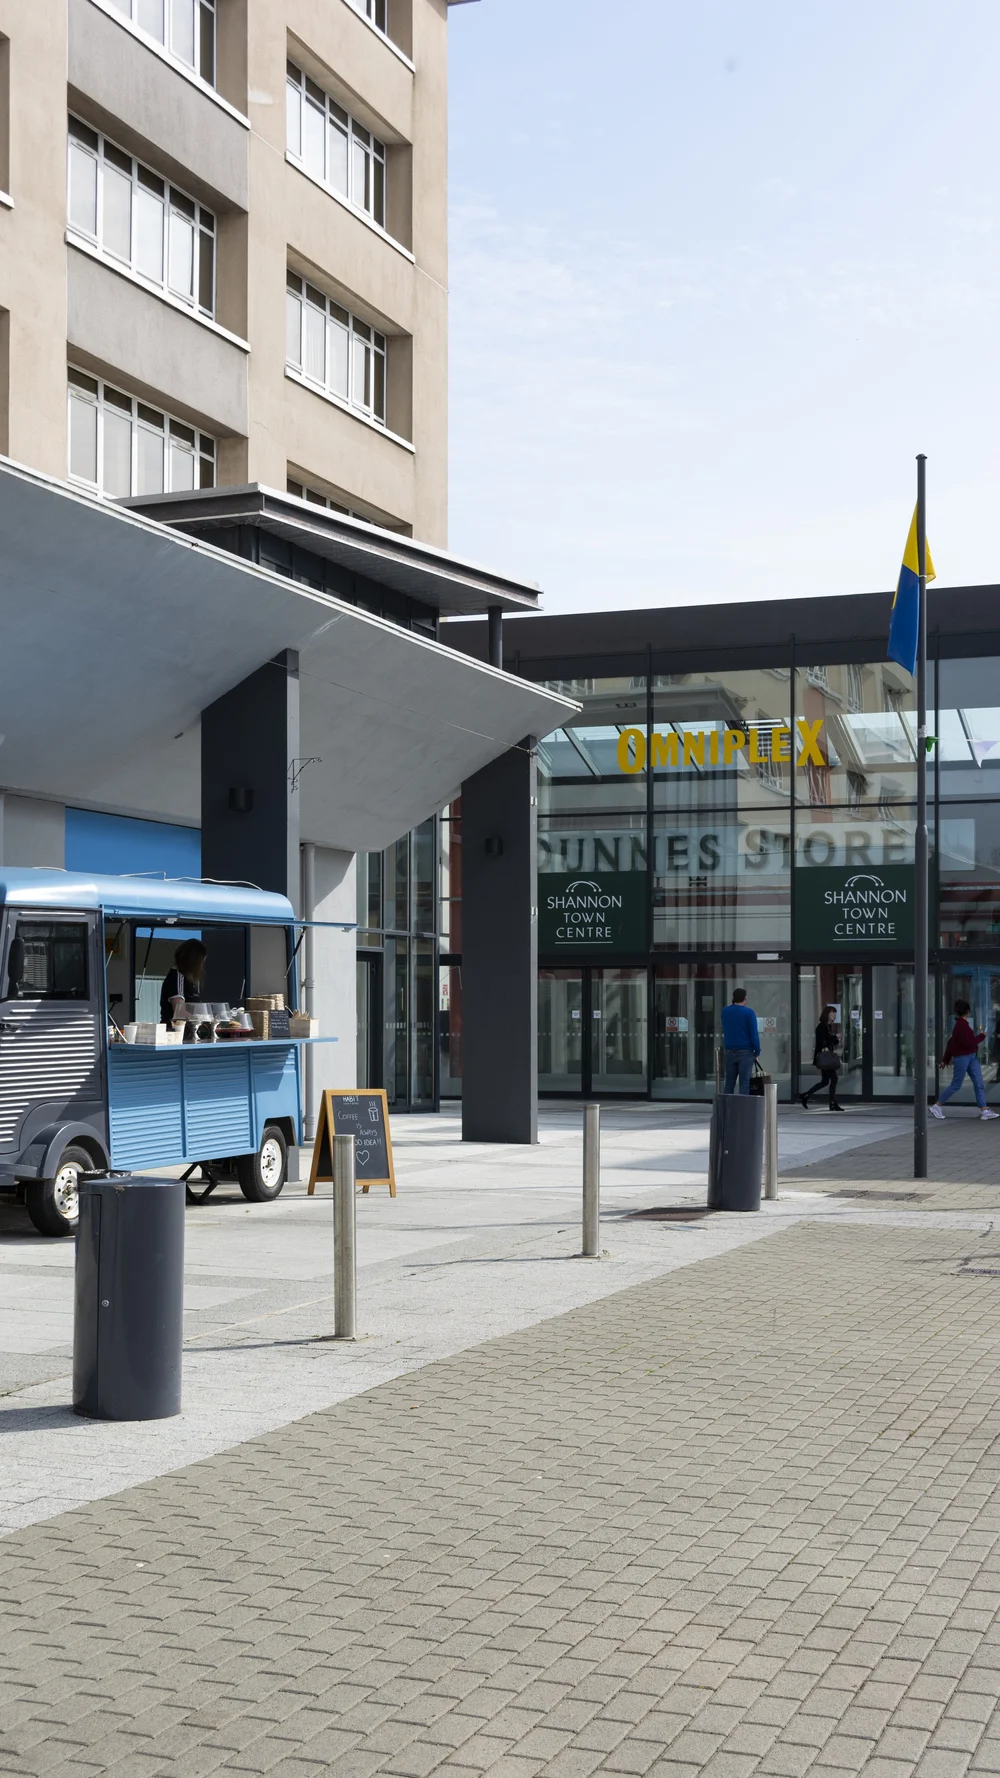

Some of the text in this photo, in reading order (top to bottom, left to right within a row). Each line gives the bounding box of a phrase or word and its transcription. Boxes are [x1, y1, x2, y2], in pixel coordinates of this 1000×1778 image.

[617, 719, 825, 774] OMNIPLEX
[744, 828, 932, 870] STORE
[547, 895, 622, 909] SHANNON
[824, 889, 907, 905] SHANNON
[563, 912, 605, 924] TOWN
[842, 907, 888, 919] TOWN
[556, 926, 612, 938] CENTRE
[834, 922, 896, 935] CENTRE
[338, 1111, 358, 1120] COFFEE
